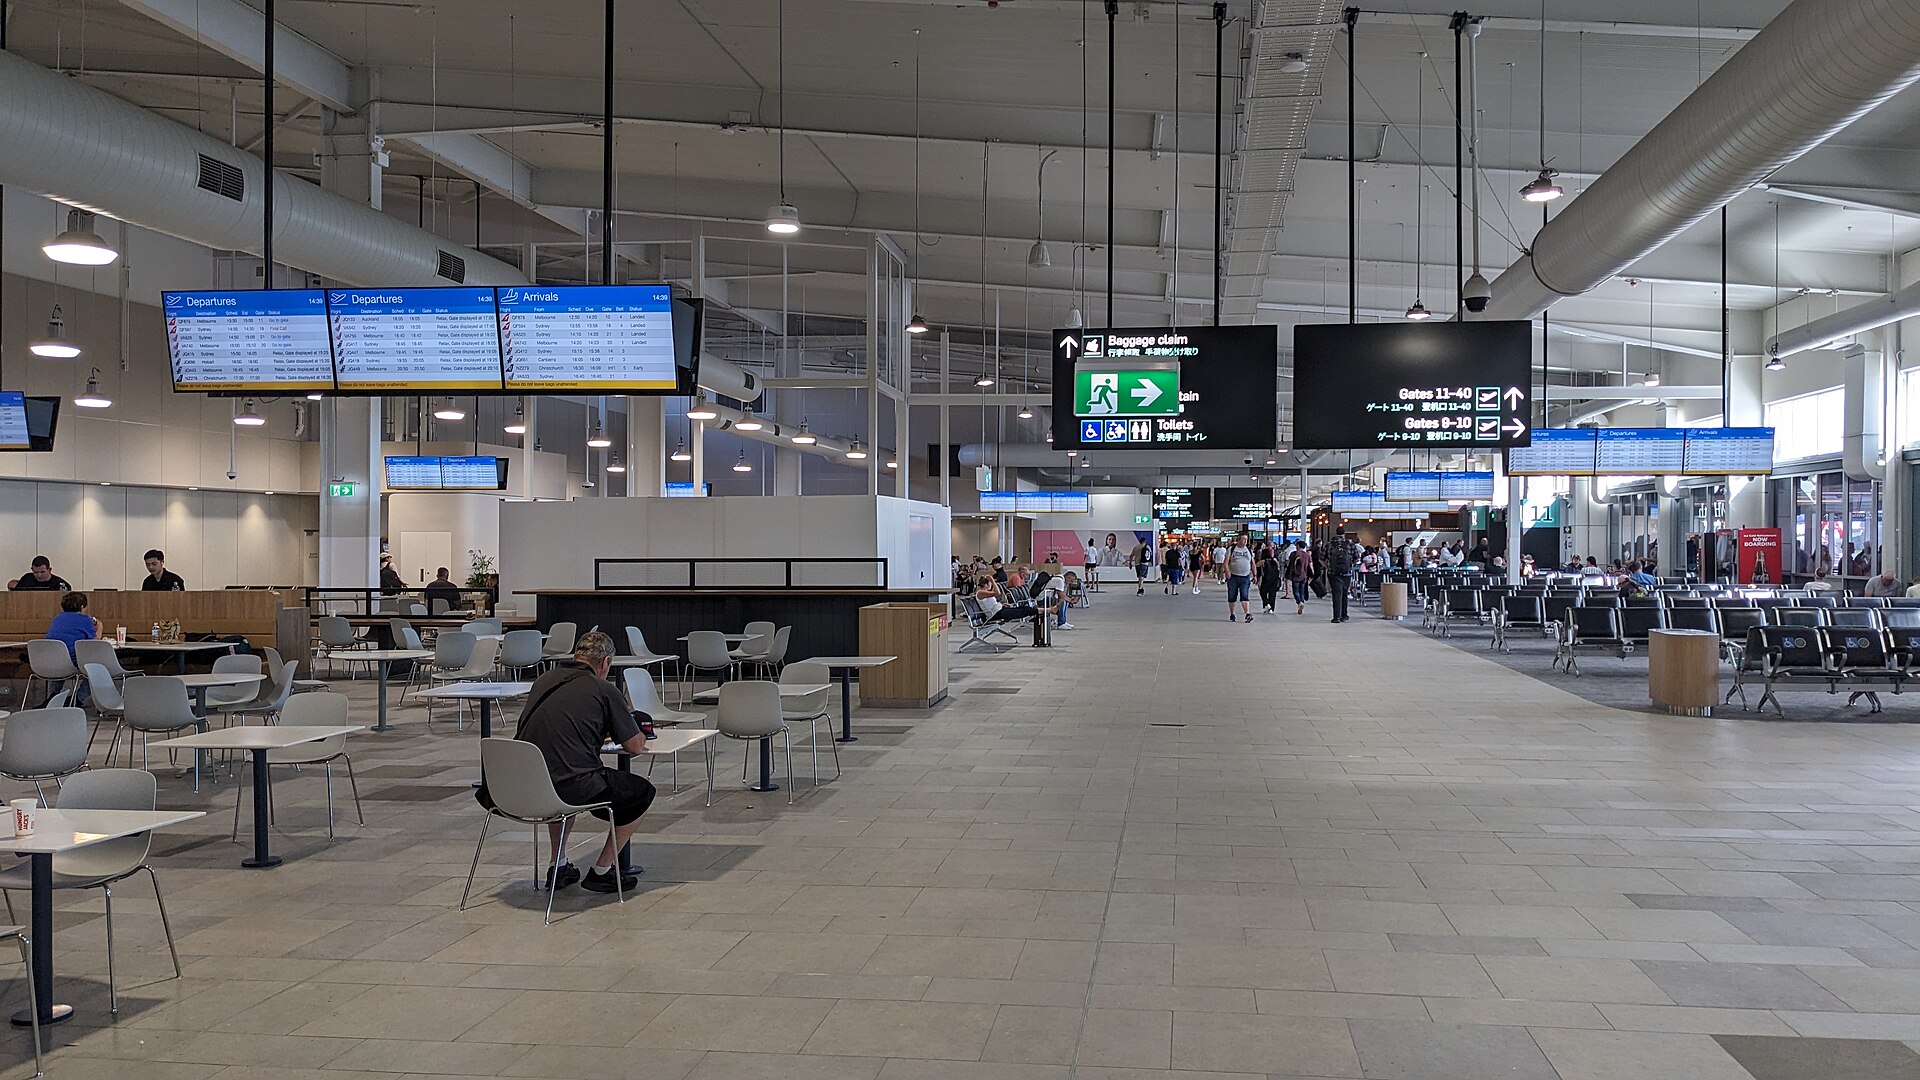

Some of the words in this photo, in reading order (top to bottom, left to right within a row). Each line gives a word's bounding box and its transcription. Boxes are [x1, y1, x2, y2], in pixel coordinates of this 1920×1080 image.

[352, 294, 403, 306] Departures
[522, 292, 559, 302] Arrivals
[186, 297, 237, 308] Departures
[1108, 335, 1155, 348] Baggage
[1158, 333, 1188, 345] claim
[1399, 388, 1433, 400] Gates
[1366, 403, 1389, 412] ゲート
[1391, 403, 1414, 411] 11-40
[1422, 402, 1446, 411] 登机口
[1449, 402, 1472, 411] 11-40
[1157, 420, 1194, 430] Toilets
[1405, 417, 1439, 429] Gates
[1185, 433, 1207, 441] トイレ
[1377, 432, 1400, 441] ゲート
[1426, 432, 1452, 440] 登机口
[1453, 432, 1472, 440] 9-10
[1531, 506, 1554, 522] 11
